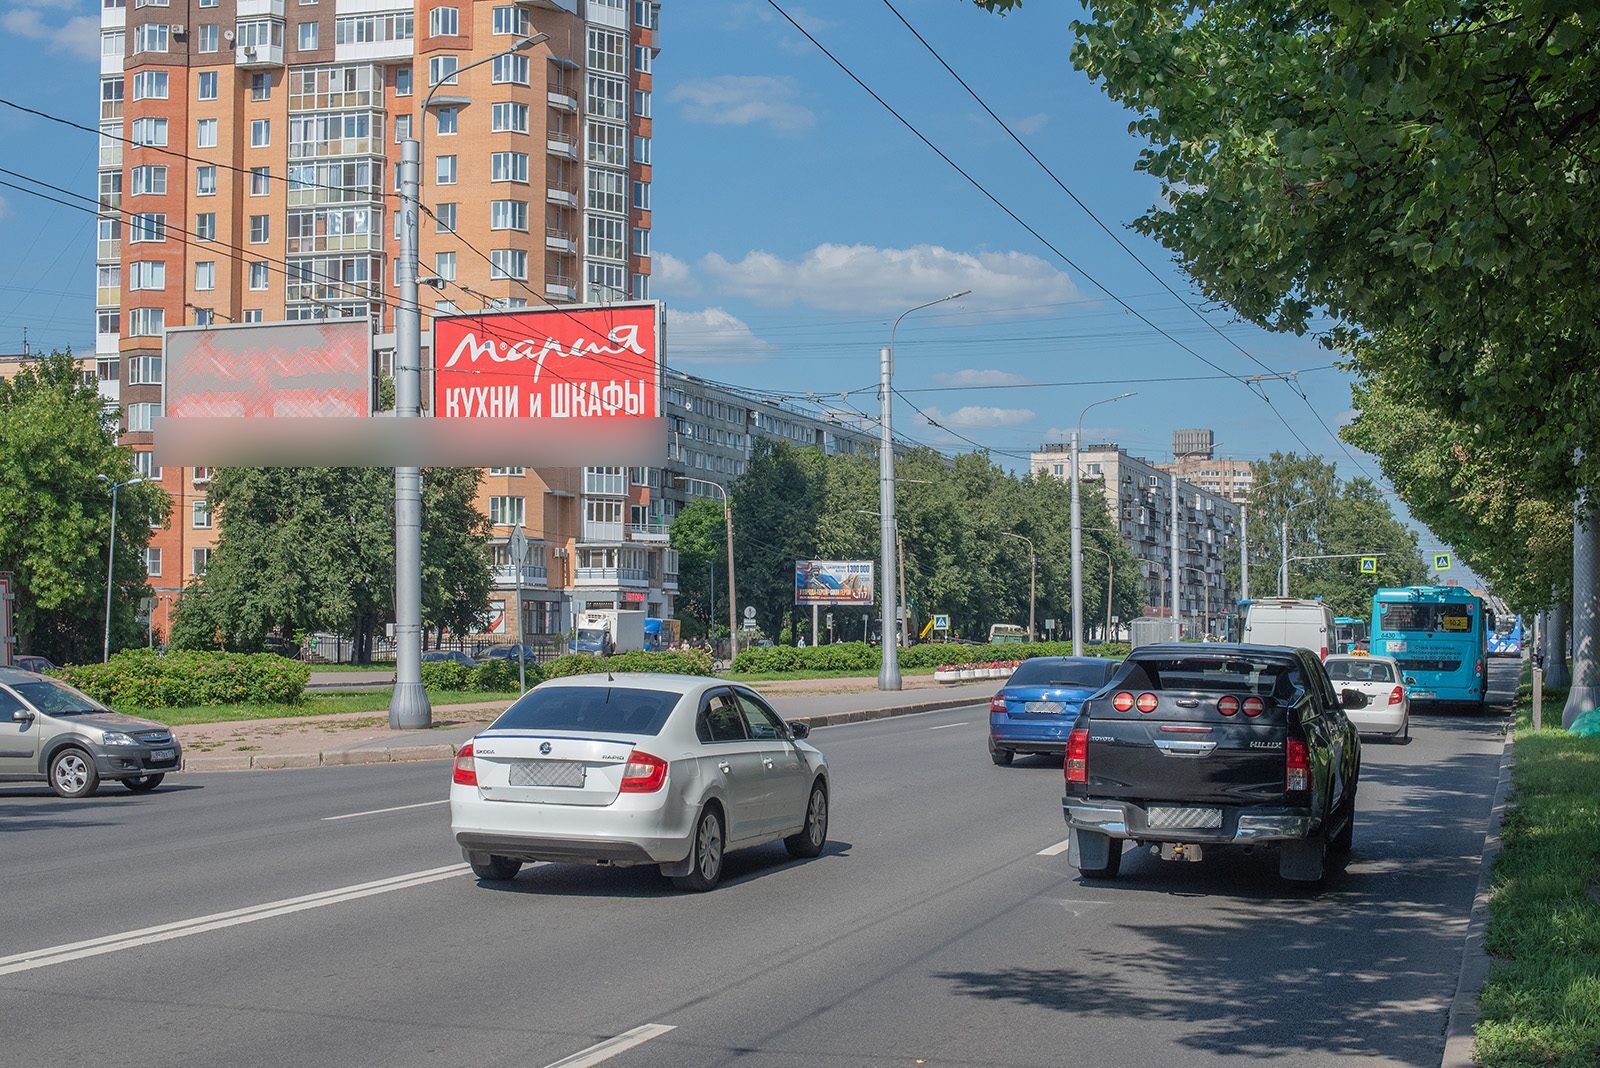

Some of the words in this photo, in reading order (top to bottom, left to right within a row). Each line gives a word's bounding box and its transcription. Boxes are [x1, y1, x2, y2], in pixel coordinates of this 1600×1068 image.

[446, 386, 518, 418] КУХНИ
[529, 393, 542, 418] и
[551, 379, 645, 417] ШКАФЫ
